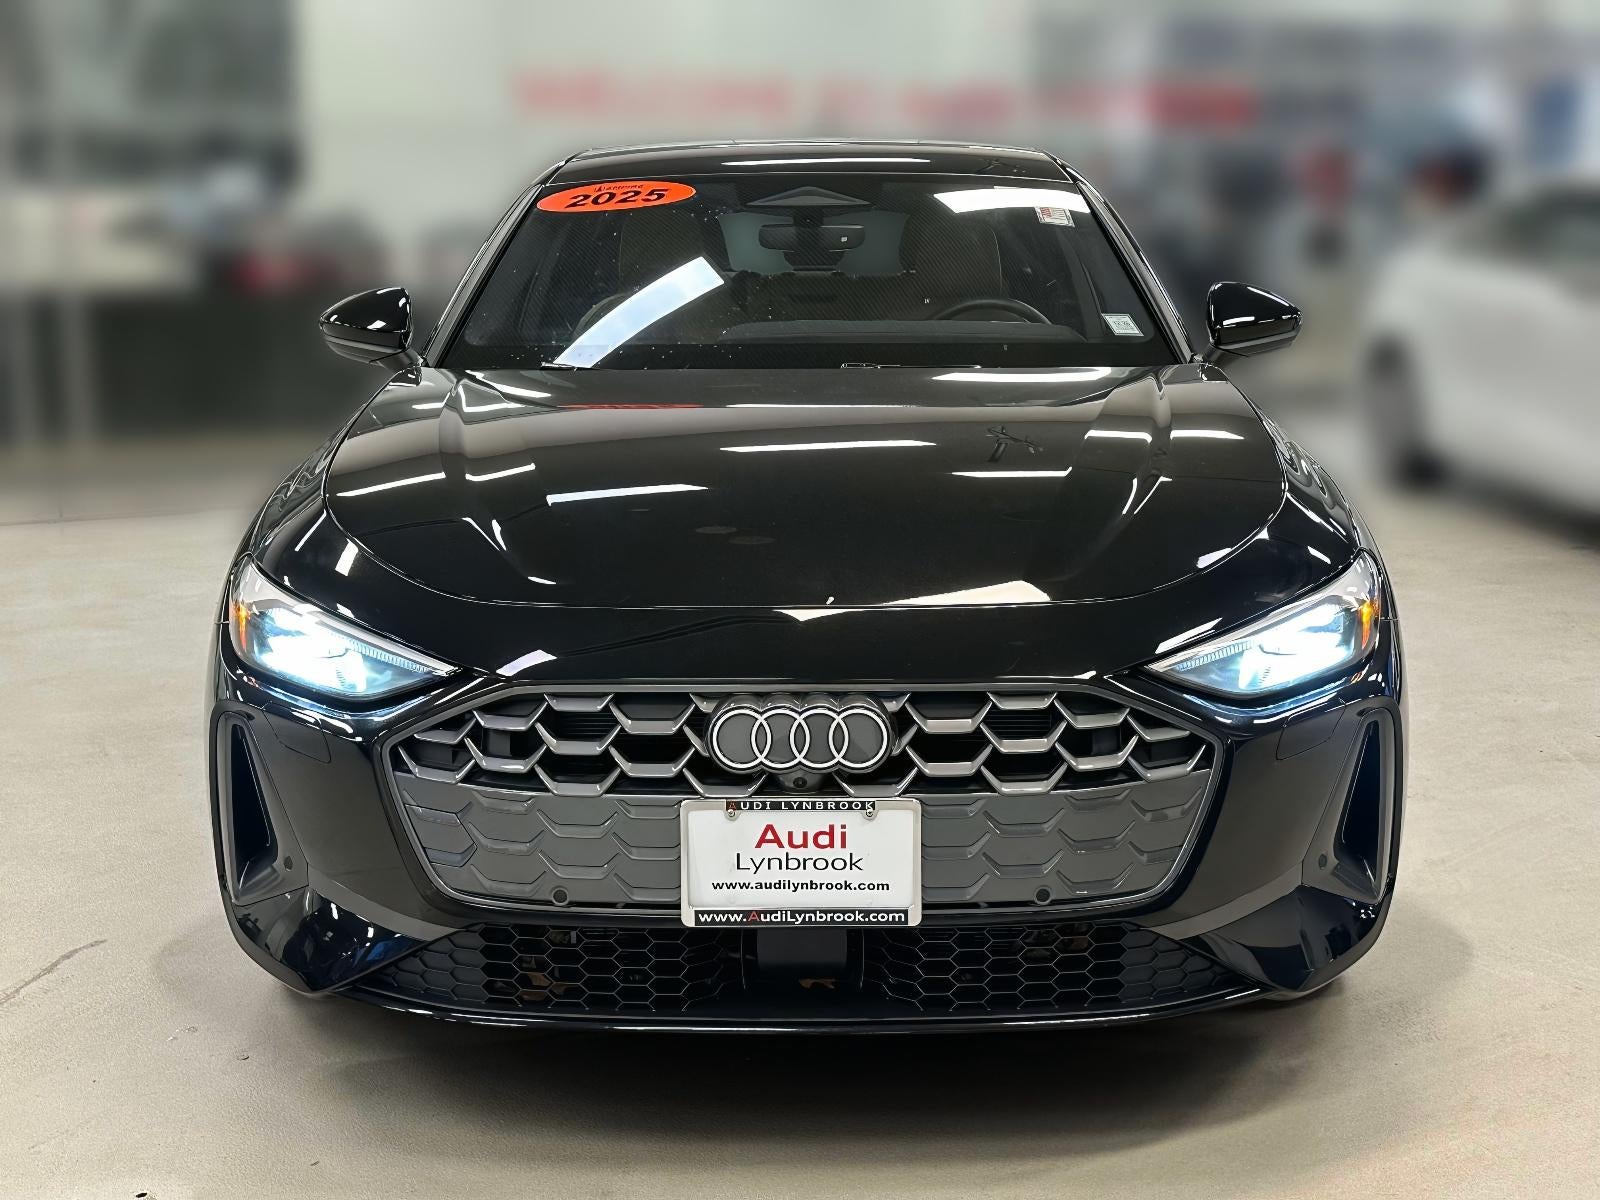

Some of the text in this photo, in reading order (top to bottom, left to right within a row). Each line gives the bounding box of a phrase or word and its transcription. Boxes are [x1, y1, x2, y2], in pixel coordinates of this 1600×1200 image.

[564, 188, 669, 209] 2025
[781, 801, 873, 810] LYNBROOK
[755, 824, 847, 849] Audi
[736, 852, 863, 874] Lynbrook
[712, 880, 890, 892] www.audilynbrook.com
[698, 910, 906, 924] www.AudiLynbrook.com
